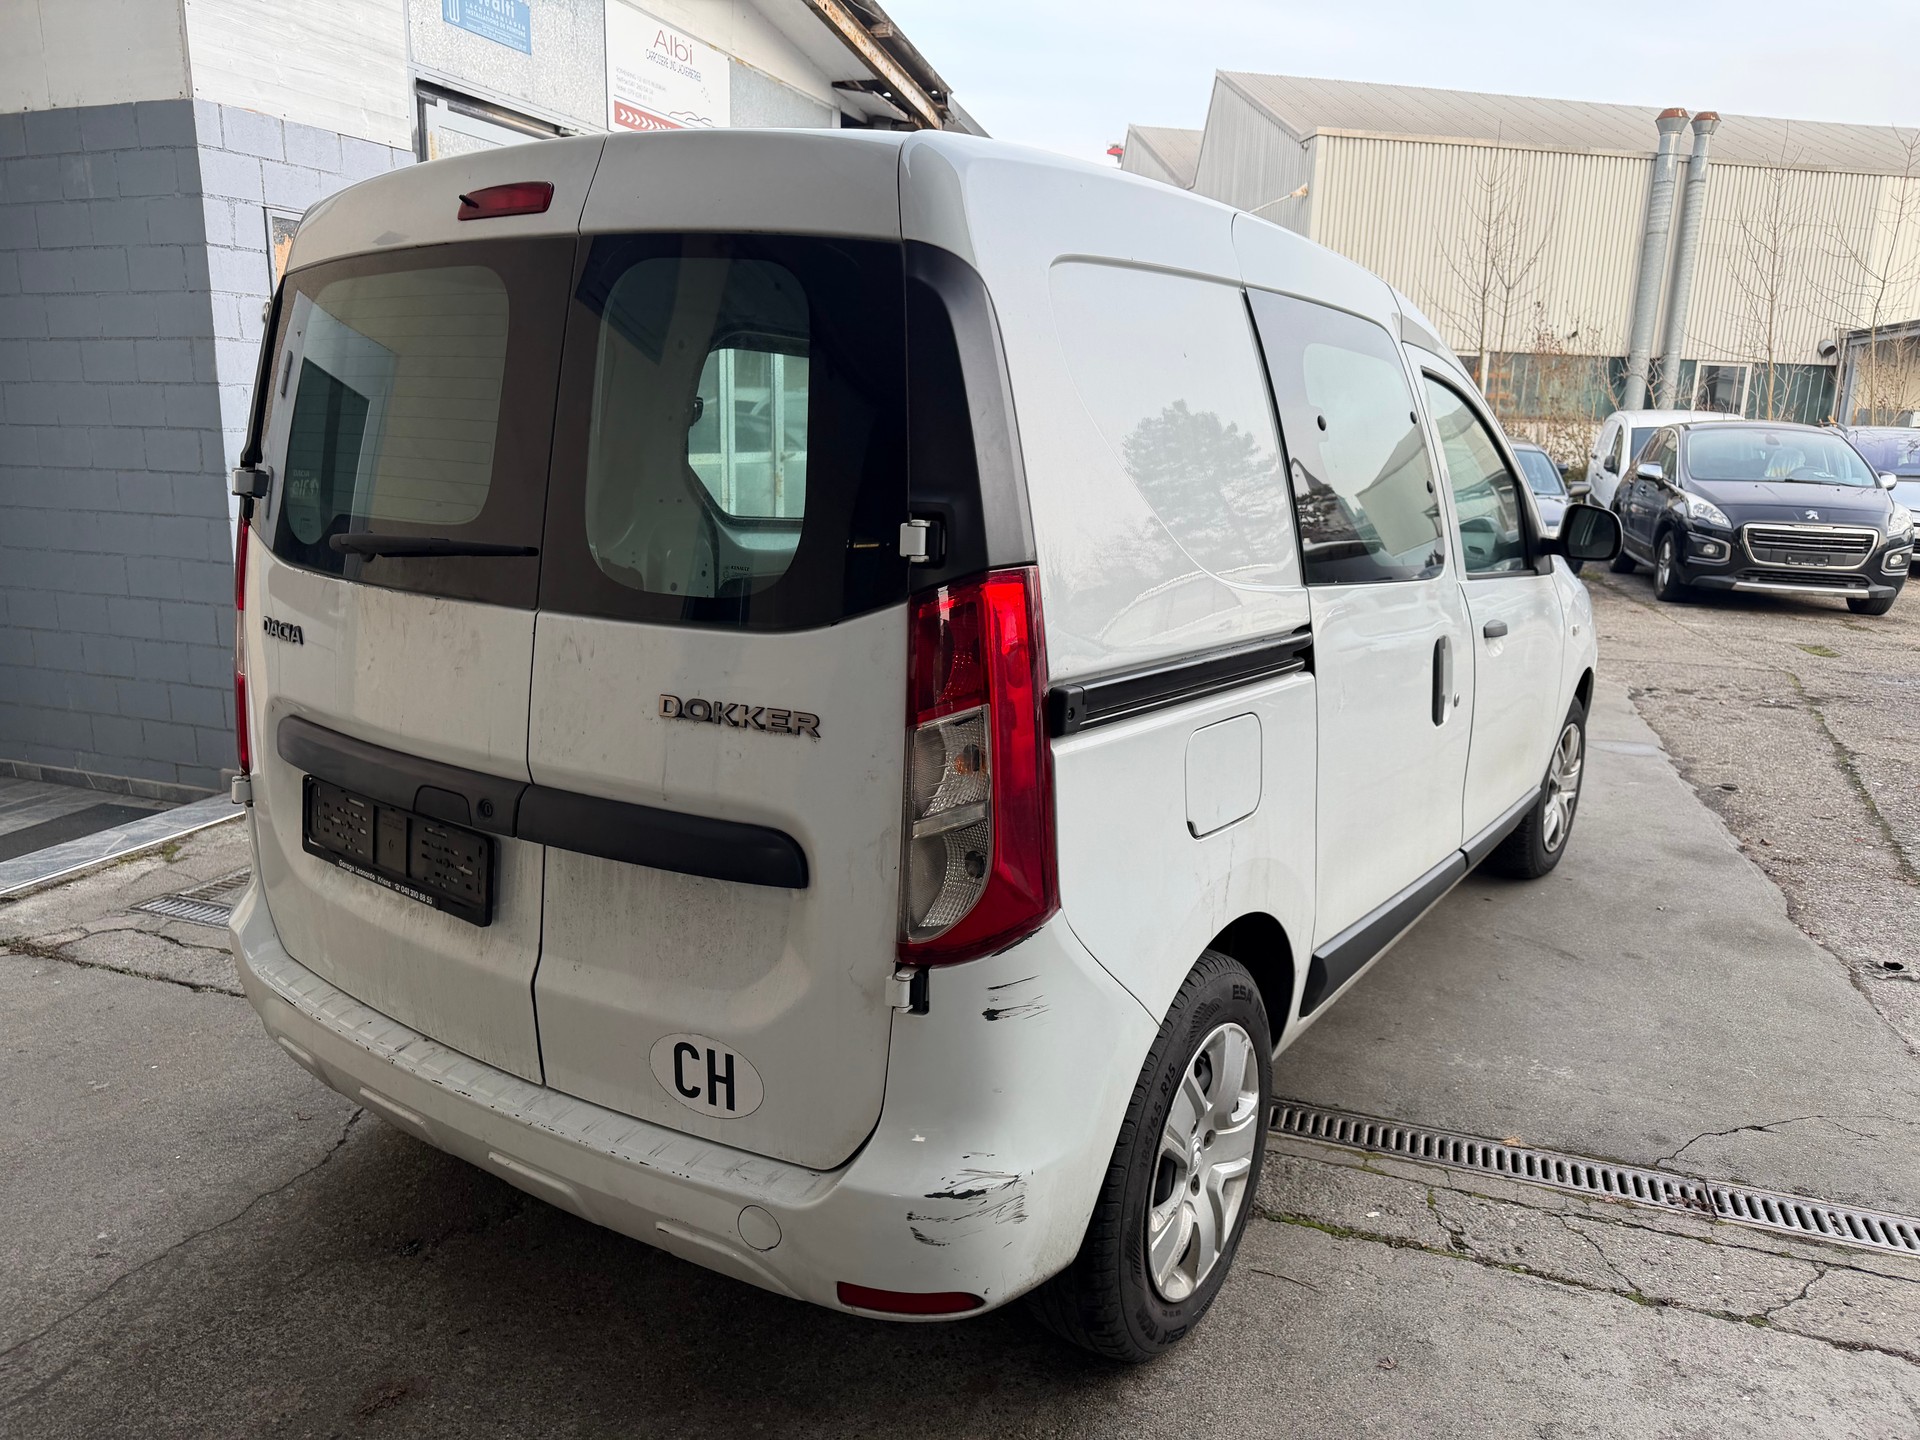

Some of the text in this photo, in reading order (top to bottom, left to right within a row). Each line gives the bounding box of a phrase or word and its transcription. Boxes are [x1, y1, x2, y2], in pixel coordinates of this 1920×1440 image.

[653, 29, 693, 65] Albi
[263, 615, 304, 646] DACIA
[658, 693, 822, 739] DOKKER
[338, 859, 355, 874] Garage
[673, 1041, 736, 1112] CH
[1160, 1062, 1176, 1098] R15
